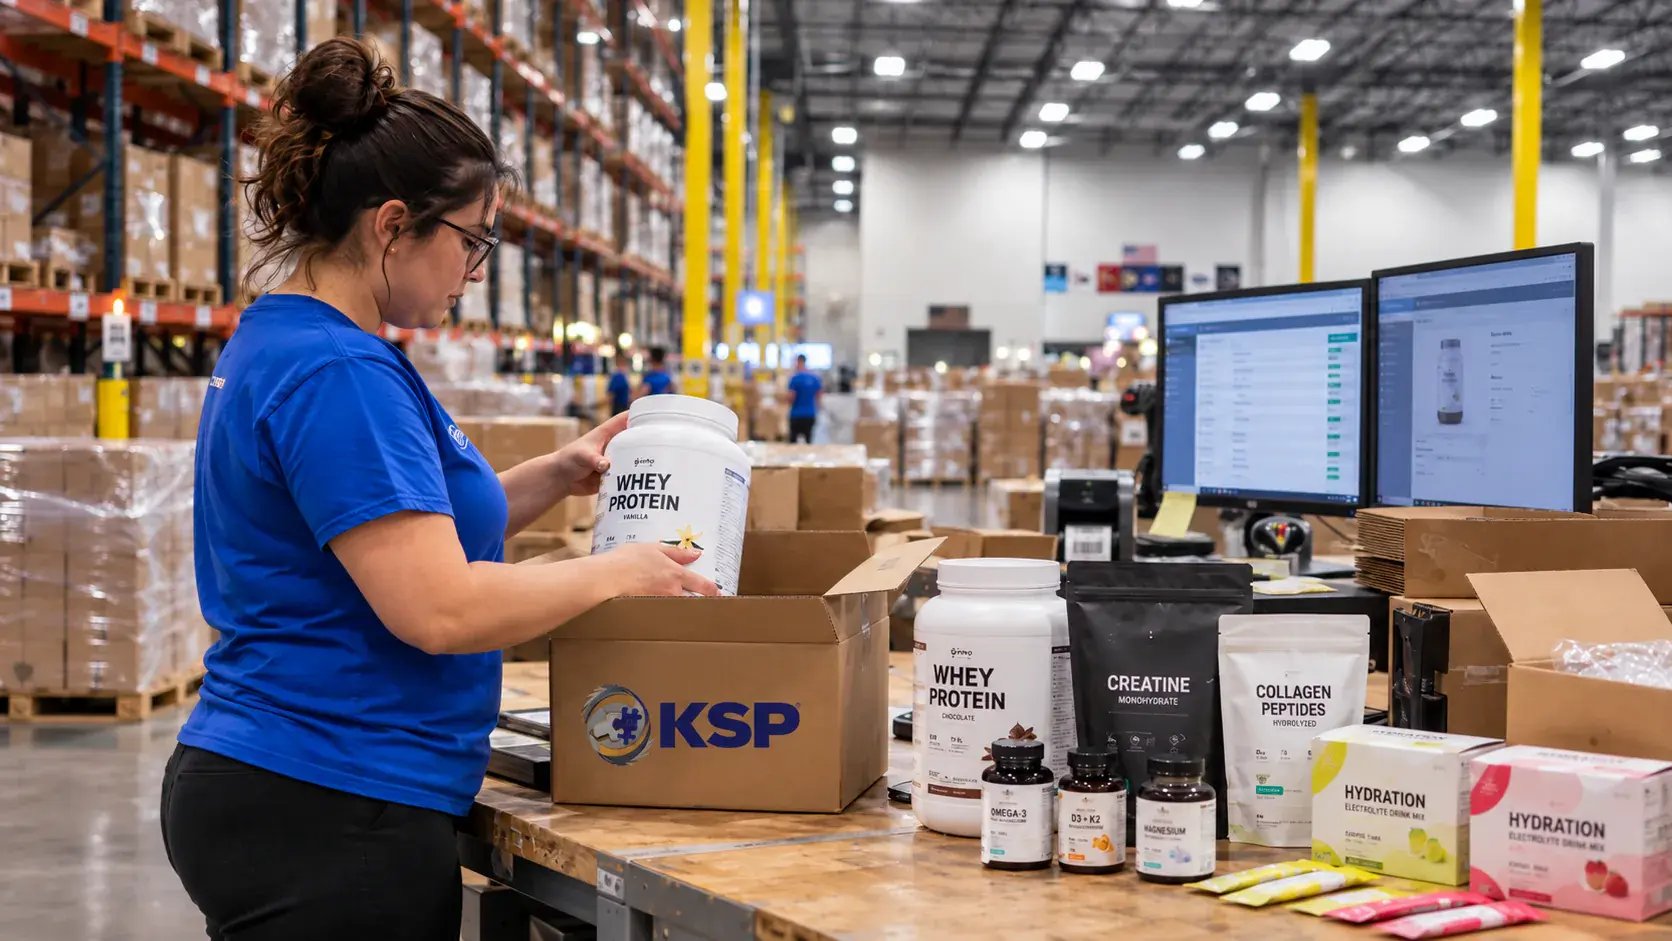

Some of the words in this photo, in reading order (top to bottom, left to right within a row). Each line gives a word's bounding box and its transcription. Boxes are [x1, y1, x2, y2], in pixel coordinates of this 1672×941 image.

[616, 473, 672, 492] WHEY
[608, 493, 680, 512] PROTEIN
[933, 664, 994, 687] WHEY
[1107, 674, 1191, 693] CREATINE
[929, 688, 1006, 710] PROTEIN
[1256, 684, 1332, 699] COLLAGEN
[1117, 696, 1179, 706] MONOHYDRATE
[941, 712, 976, 721] CHOCOLATE
[1261, 702, 1326, 717] PEPTIDES
[659, 701, 801, 749] KSP
[1272, 719, 1317, 728] HYDROLYZED
[1344, 784, 1426, 809] HYDRATION
[990, 808, 1027, 818] OMEGA-3
[1071, 813, 1082, 823] D3
[1089, 814, 1101, 824] K2
[1344, 803, 1388, 816] ELECTROLYTE
[1389, 809, 1411, 819] DRINK
[1143, 824, 1187, 835] MAGNESIUM
[1508, 811, 1606, 839] HYDRATION
[1508, 831, 1560, 846] ELECTROLYTE
